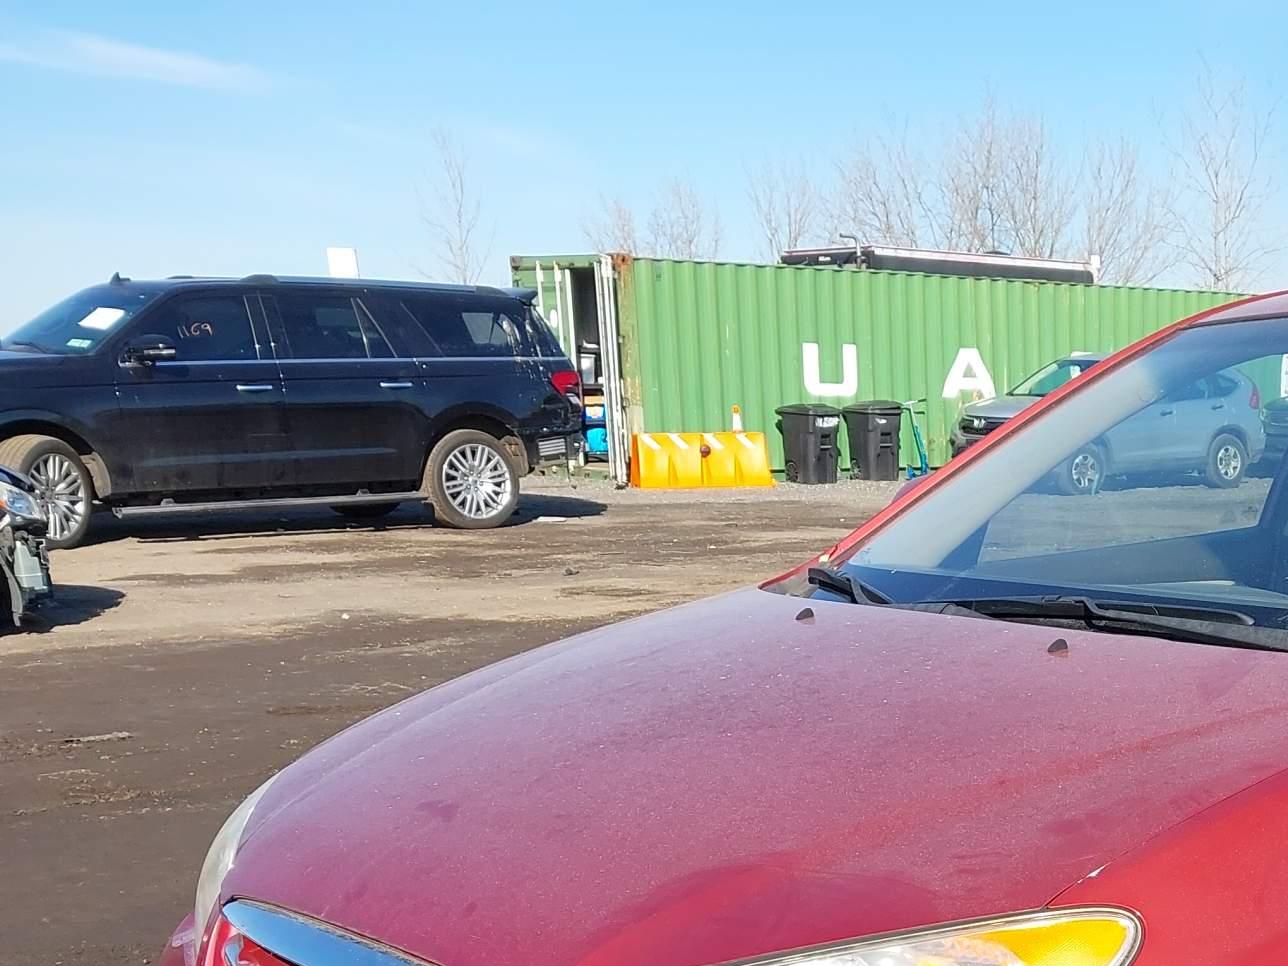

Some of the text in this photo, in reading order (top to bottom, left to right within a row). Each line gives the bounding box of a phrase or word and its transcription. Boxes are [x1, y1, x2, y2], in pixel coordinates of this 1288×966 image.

[177, 322, 213, 339] 1169
[802, 342, 997, 399] U A
